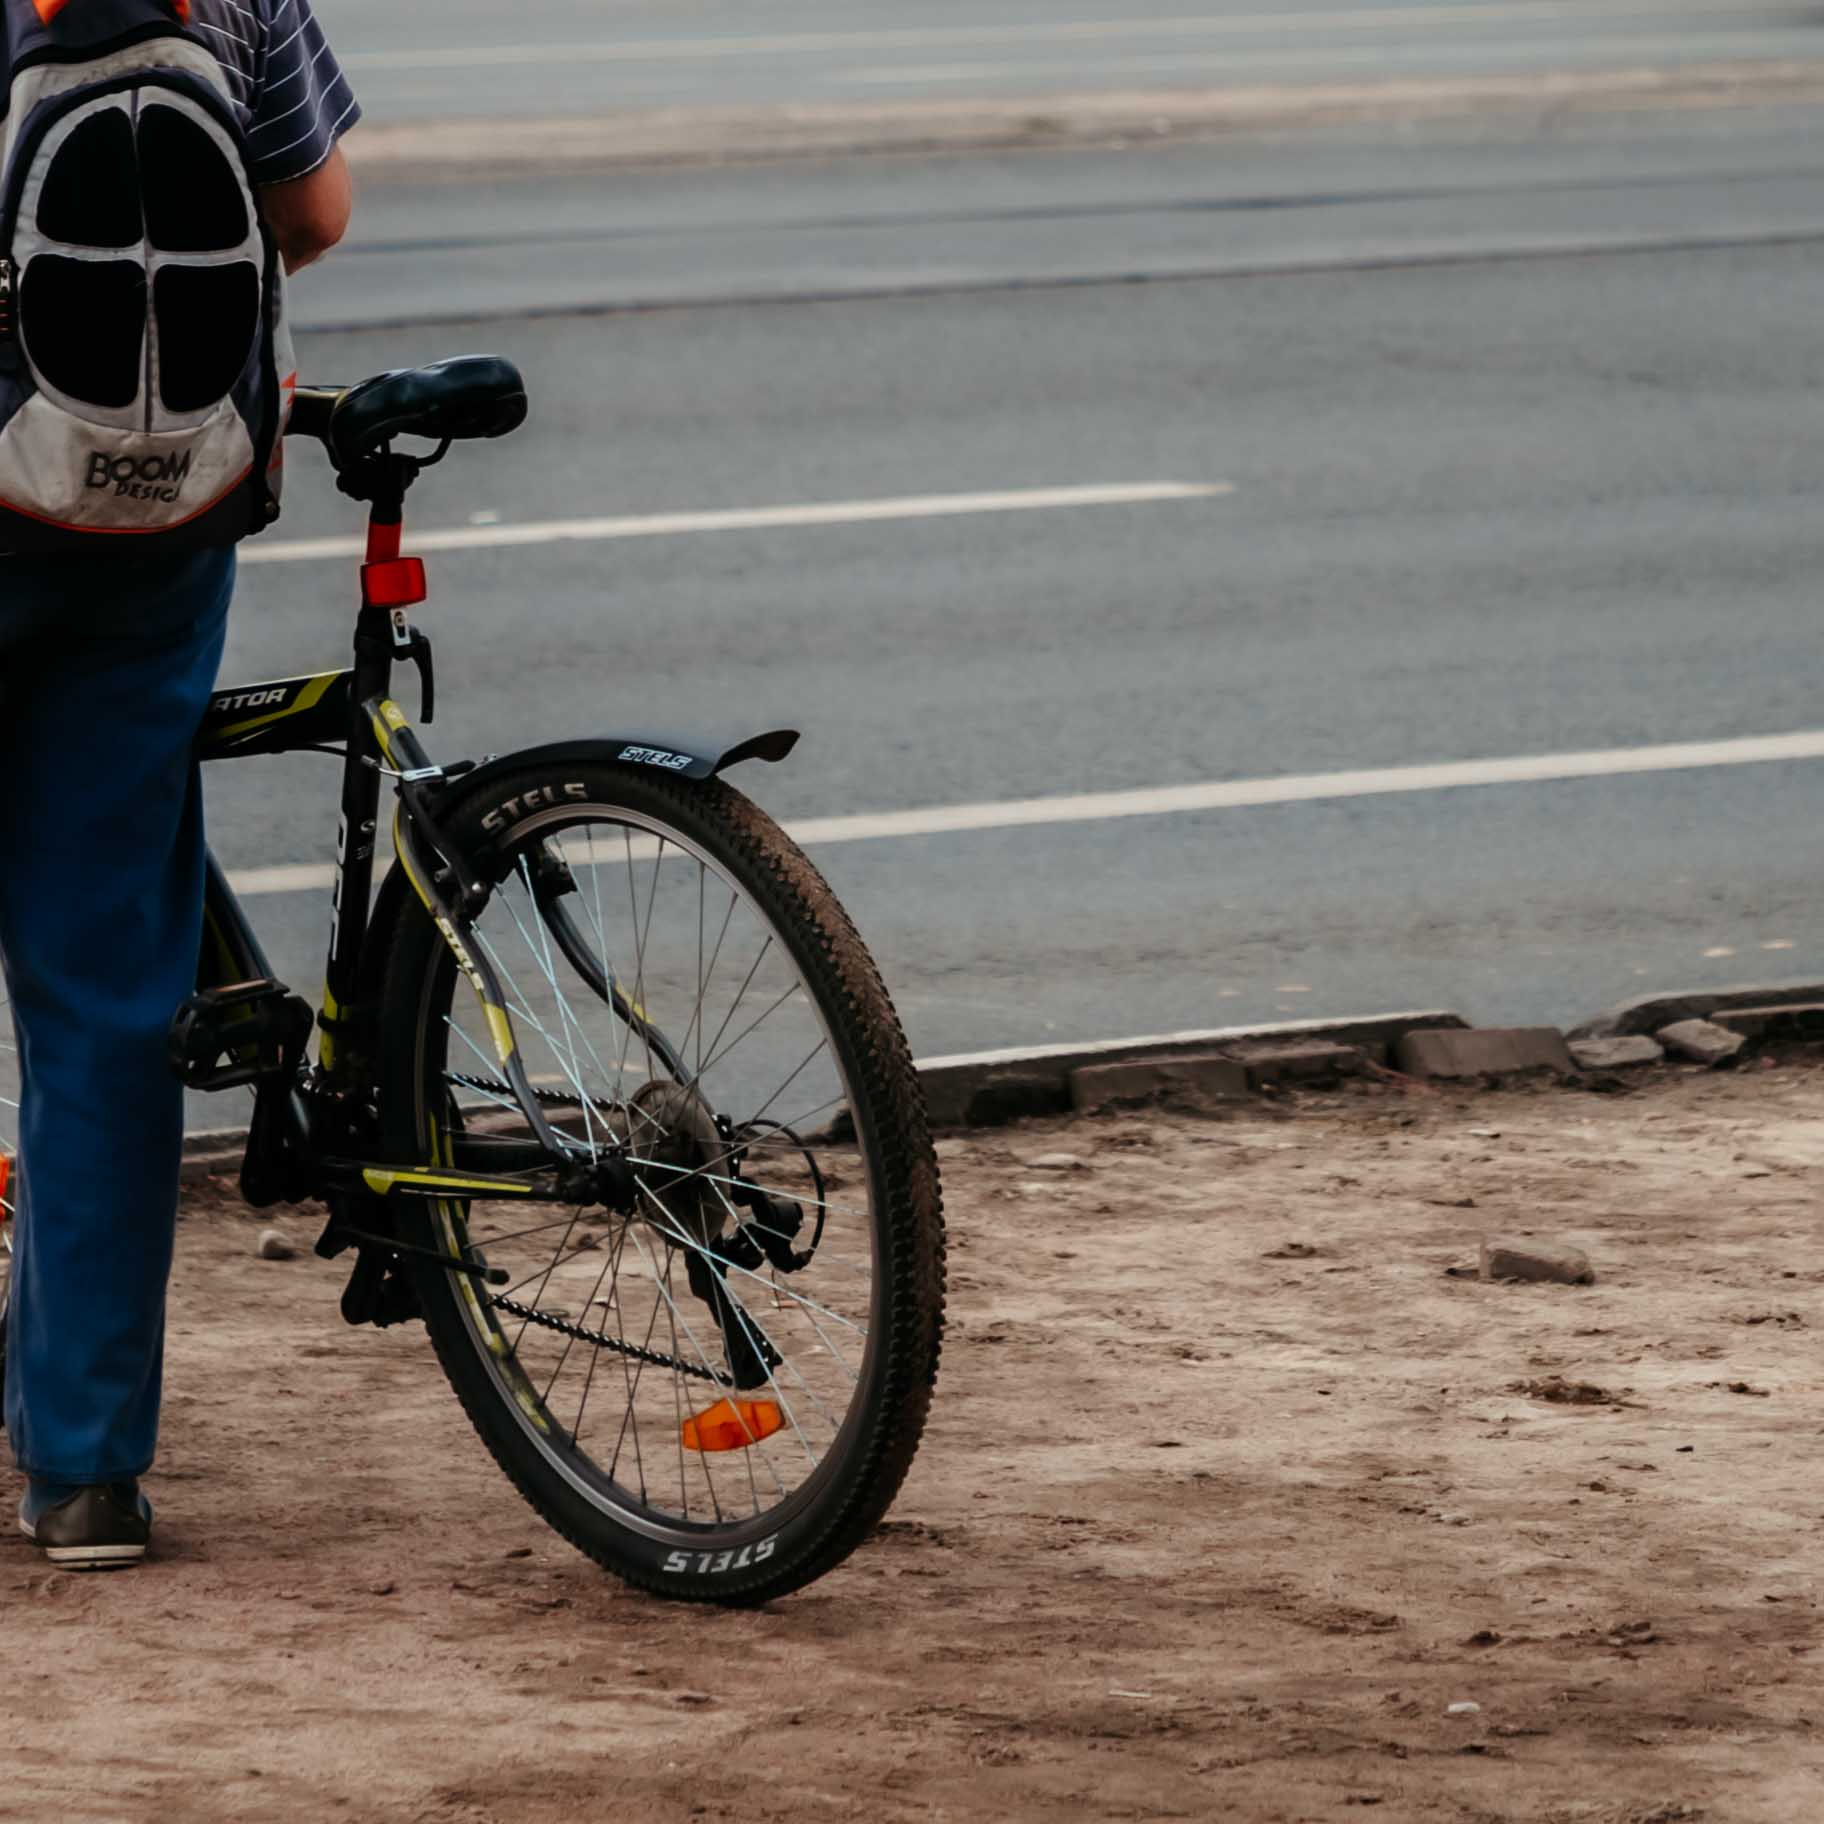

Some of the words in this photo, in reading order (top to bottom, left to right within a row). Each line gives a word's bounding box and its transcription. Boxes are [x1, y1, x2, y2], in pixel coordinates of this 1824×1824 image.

[85, 448, 192, 488] BOOM
[214, 688, 287, 711] ATOR
[618, 745, 693, 770] STELS
[662, 1533, 778, 1574] STELS
